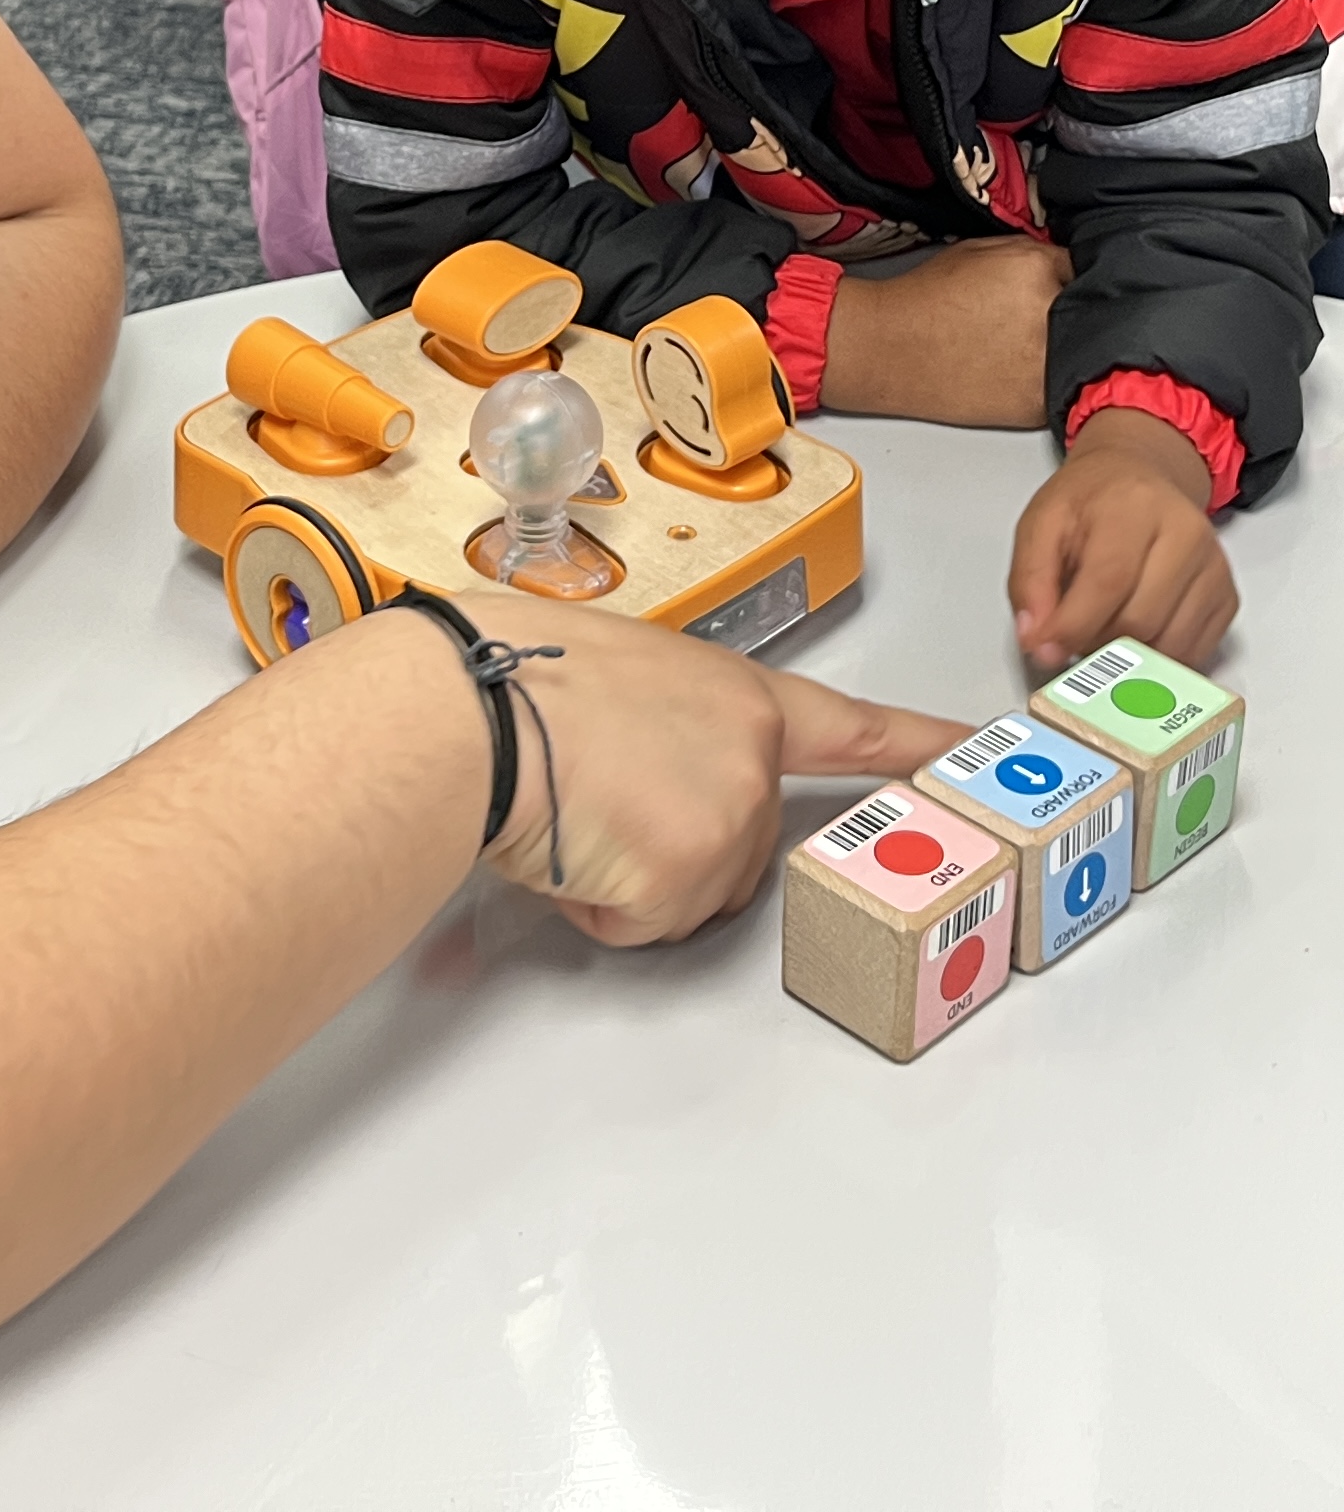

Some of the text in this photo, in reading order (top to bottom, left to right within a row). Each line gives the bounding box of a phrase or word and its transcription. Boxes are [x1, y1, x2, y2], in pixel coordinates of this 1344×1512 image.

[1159, 703, 1203, 734] BEGIN
[1031, 768, 1103, 818] FORWARD
[1174, 821, 1208, 860] BEGIN
[931, 862, 964, 886] END
[1053, 893, 1117, 951] FORWARD
[947, 991, 973, 1020] END
